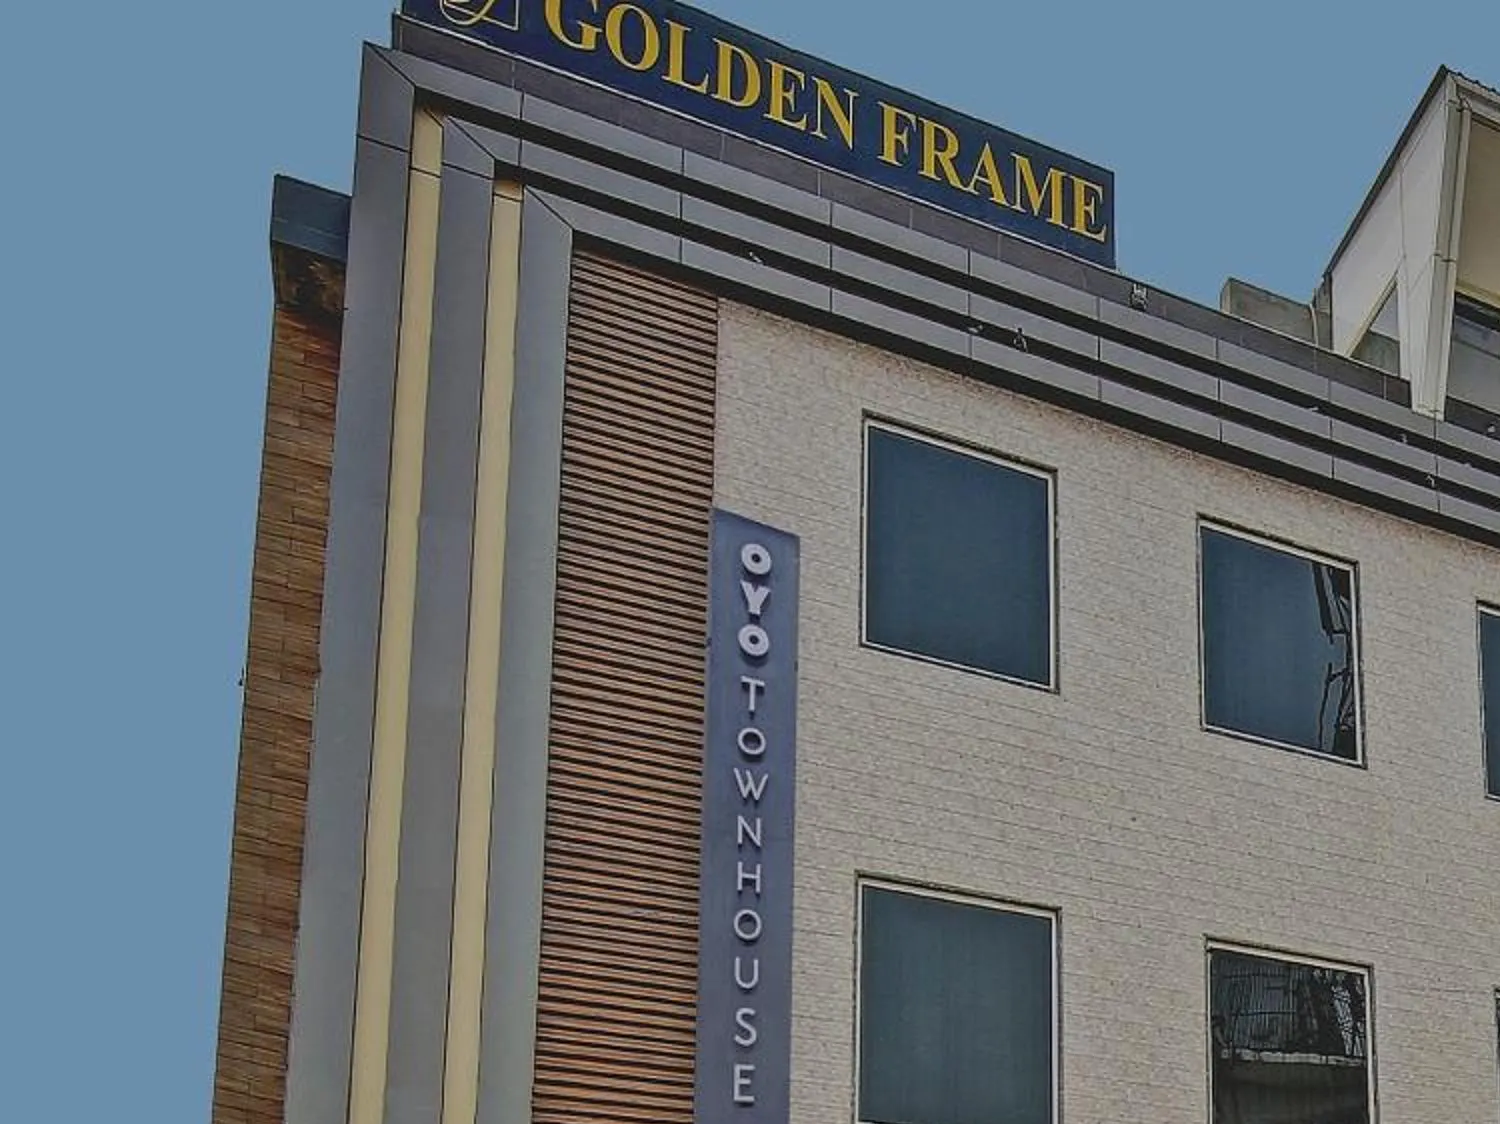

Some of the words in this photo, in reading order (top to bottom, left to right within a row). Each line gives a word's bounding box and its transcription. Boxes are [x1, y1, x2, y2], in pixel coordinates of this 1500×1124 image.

[545, 0, 858, 150] GOLDEN
[879, 101, 1107, 243] FRAME
[738, 543, 772, 658] OYO
[733, 675, 769, 1104] TOWNHOUSE
